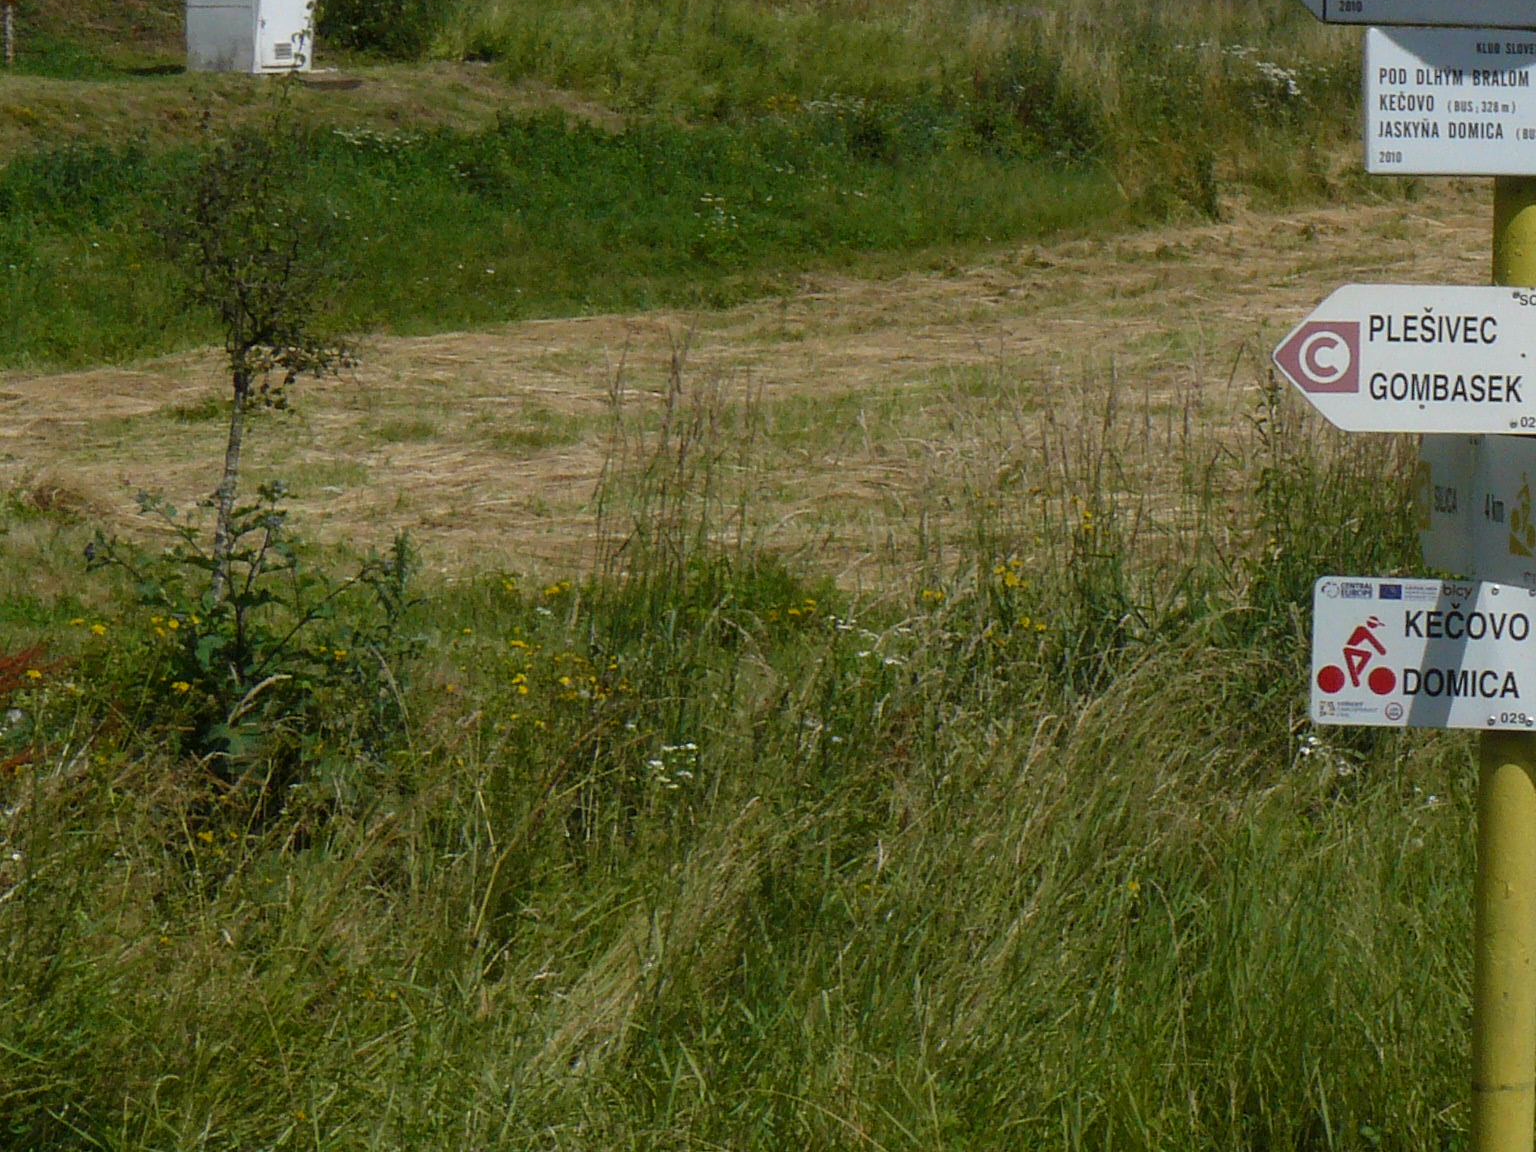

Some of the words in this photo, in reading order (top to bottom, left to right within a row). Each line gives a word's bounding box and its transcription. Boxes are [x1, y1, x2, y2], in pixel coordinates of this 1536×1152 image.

[1476, 43, 1500, 54] KLUB
[1379, 67, 1408, 85] POD
[1416, 66, 1464, 86] DLHÝM
[1472, 69, 1529, 87] BRALOM
[1379, 90, 1435, 112] KEČOVO
[1378, 118, 1440, 139] JASKYŇA
[1449, 122, 1504, 139] DOMICA
[1379, 151, 1403, 164] 2010
[1369, 306, 1499, 344] PLEŠIVEC
[1369, 371, 1523, 403] GOMBASEK
[1443, 584, 1473, 599] bicy
[1404, 602, 1531, 642] KEČOVO
[1402, 667, 1521, 699] DOMICA
[1500, 712, 1527, 725] 029
